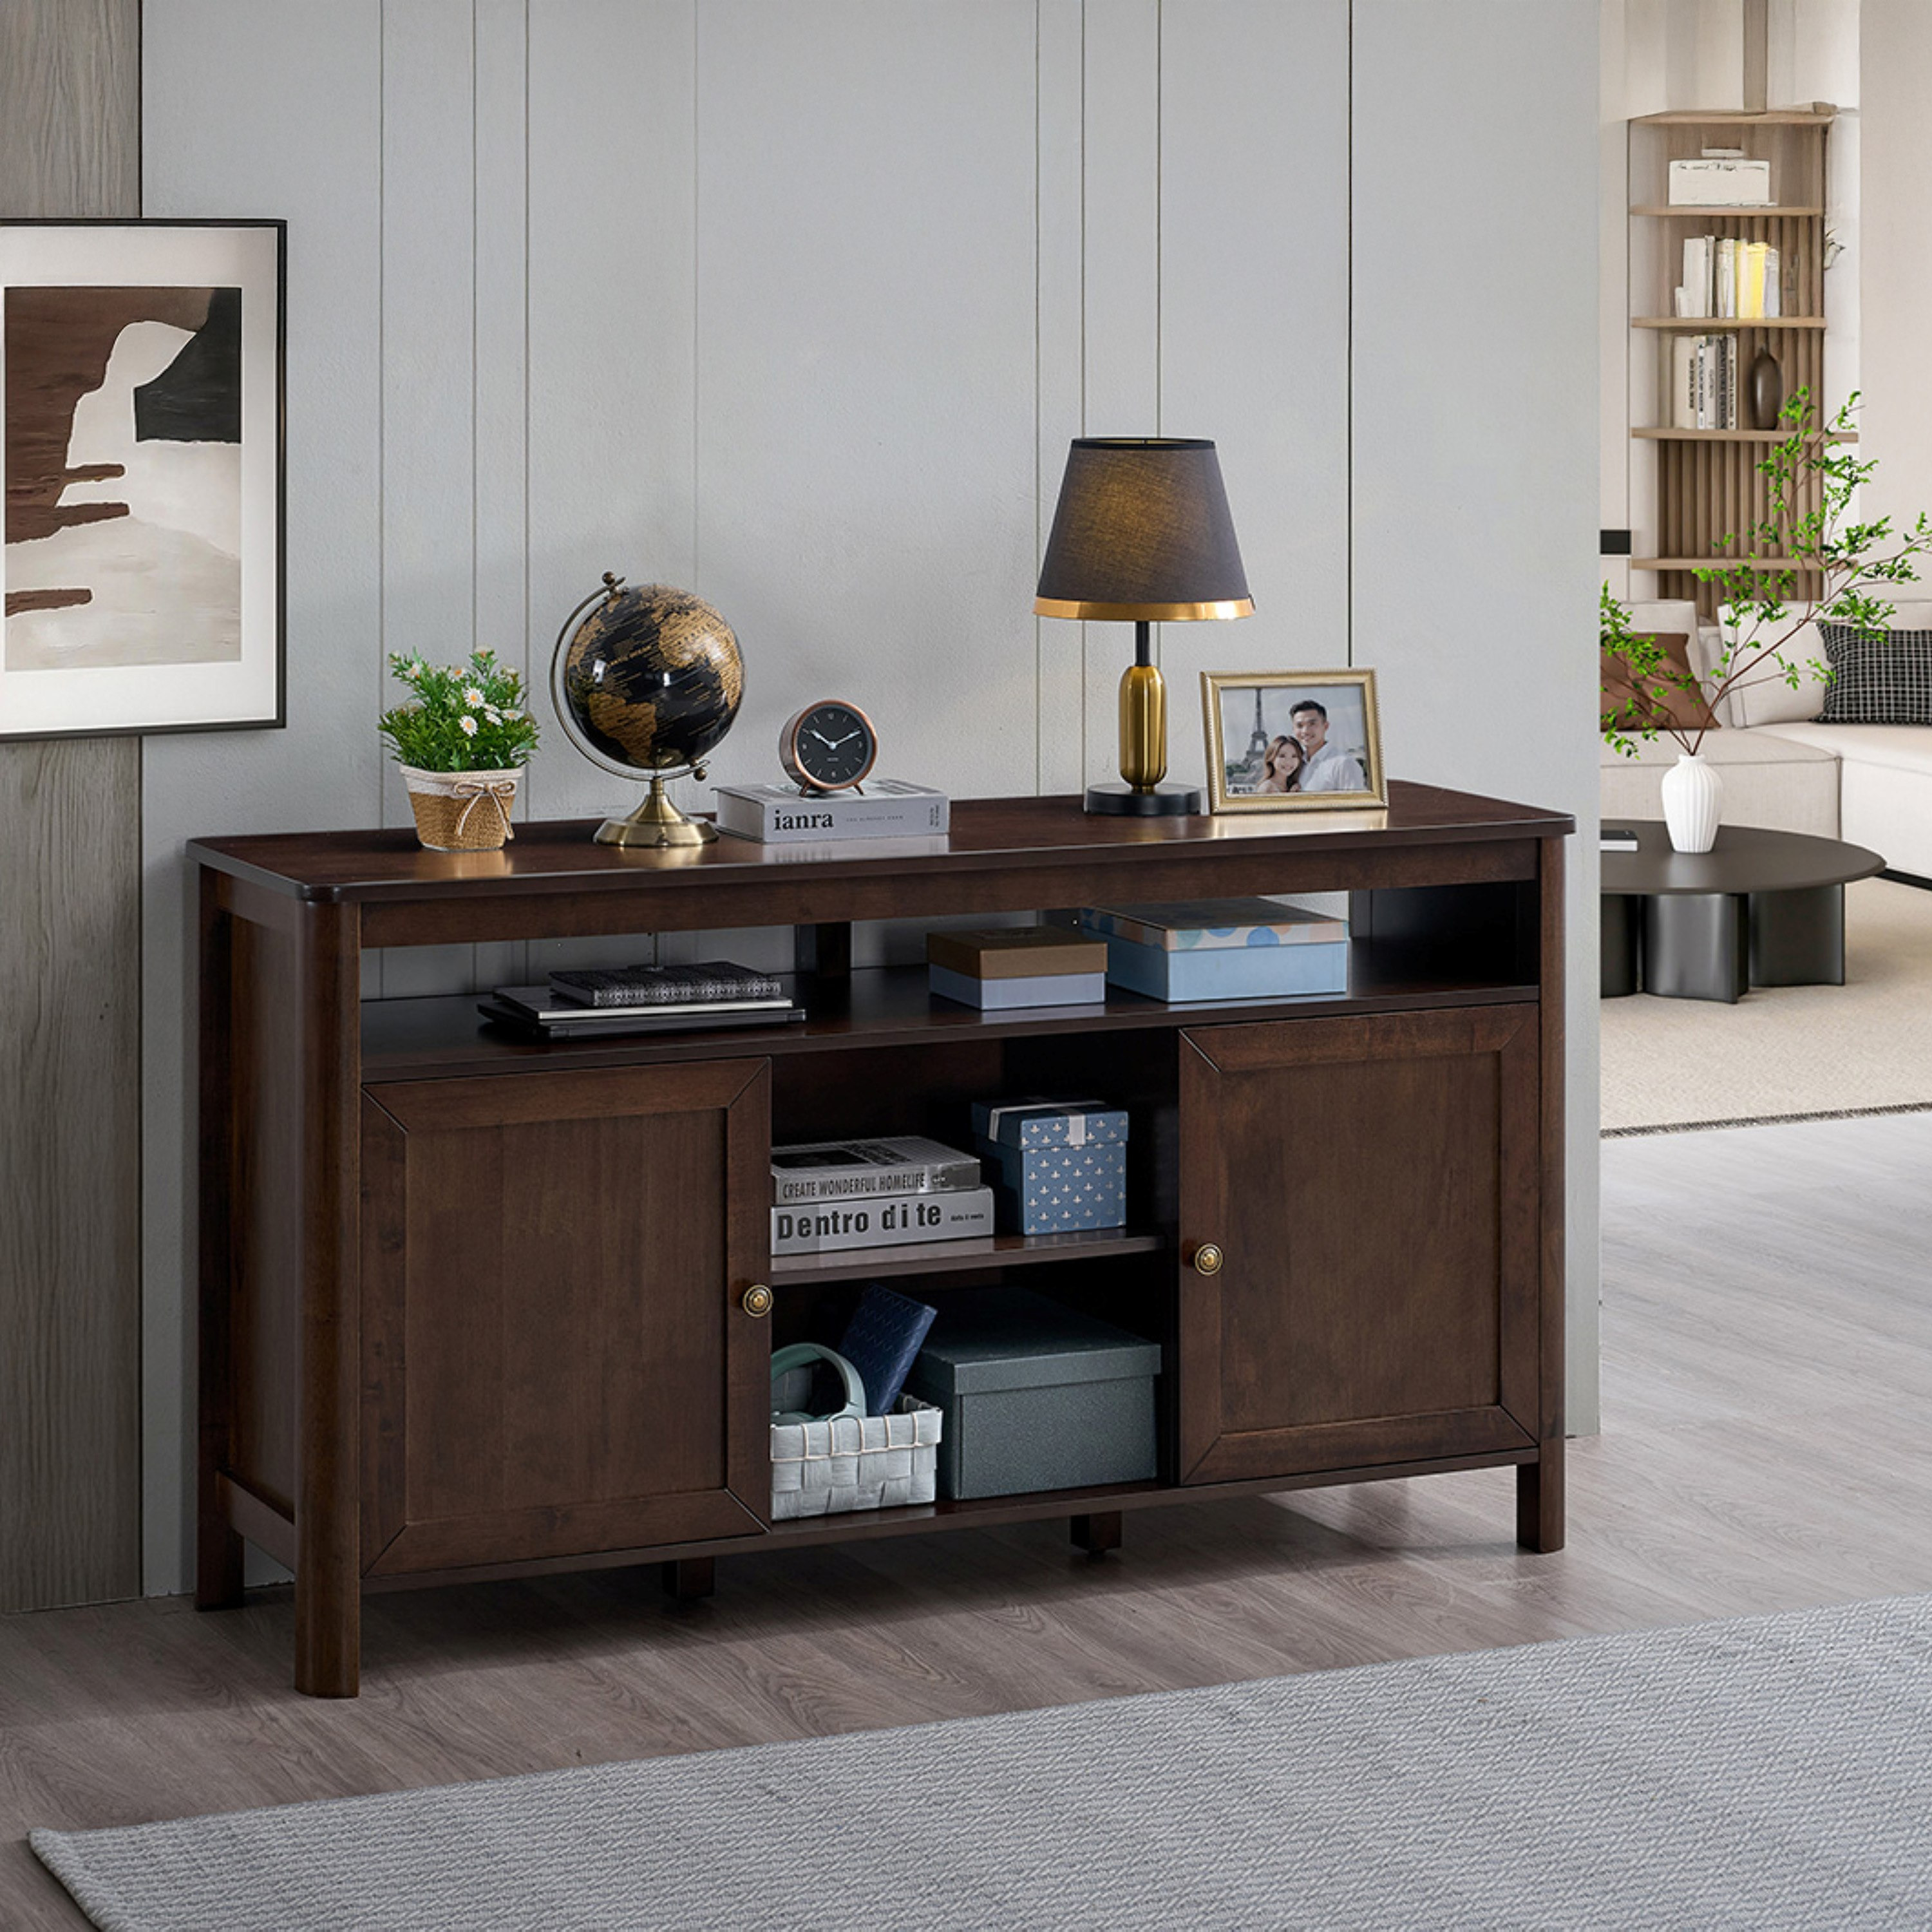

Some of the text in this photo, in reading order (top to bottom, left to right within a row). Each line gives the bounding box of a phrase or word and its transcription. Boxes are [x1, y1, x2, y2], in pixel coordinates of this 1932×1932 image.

[773, 810, 835, 831] ianra
[783, 1181, 817, 1198] CREATE
[819, 1177, 876, 1195] WONDERFUL
[879, 1173, 925, 1191] HOMELIFE
[777, 1202, 941, 1240] Dentro di te
